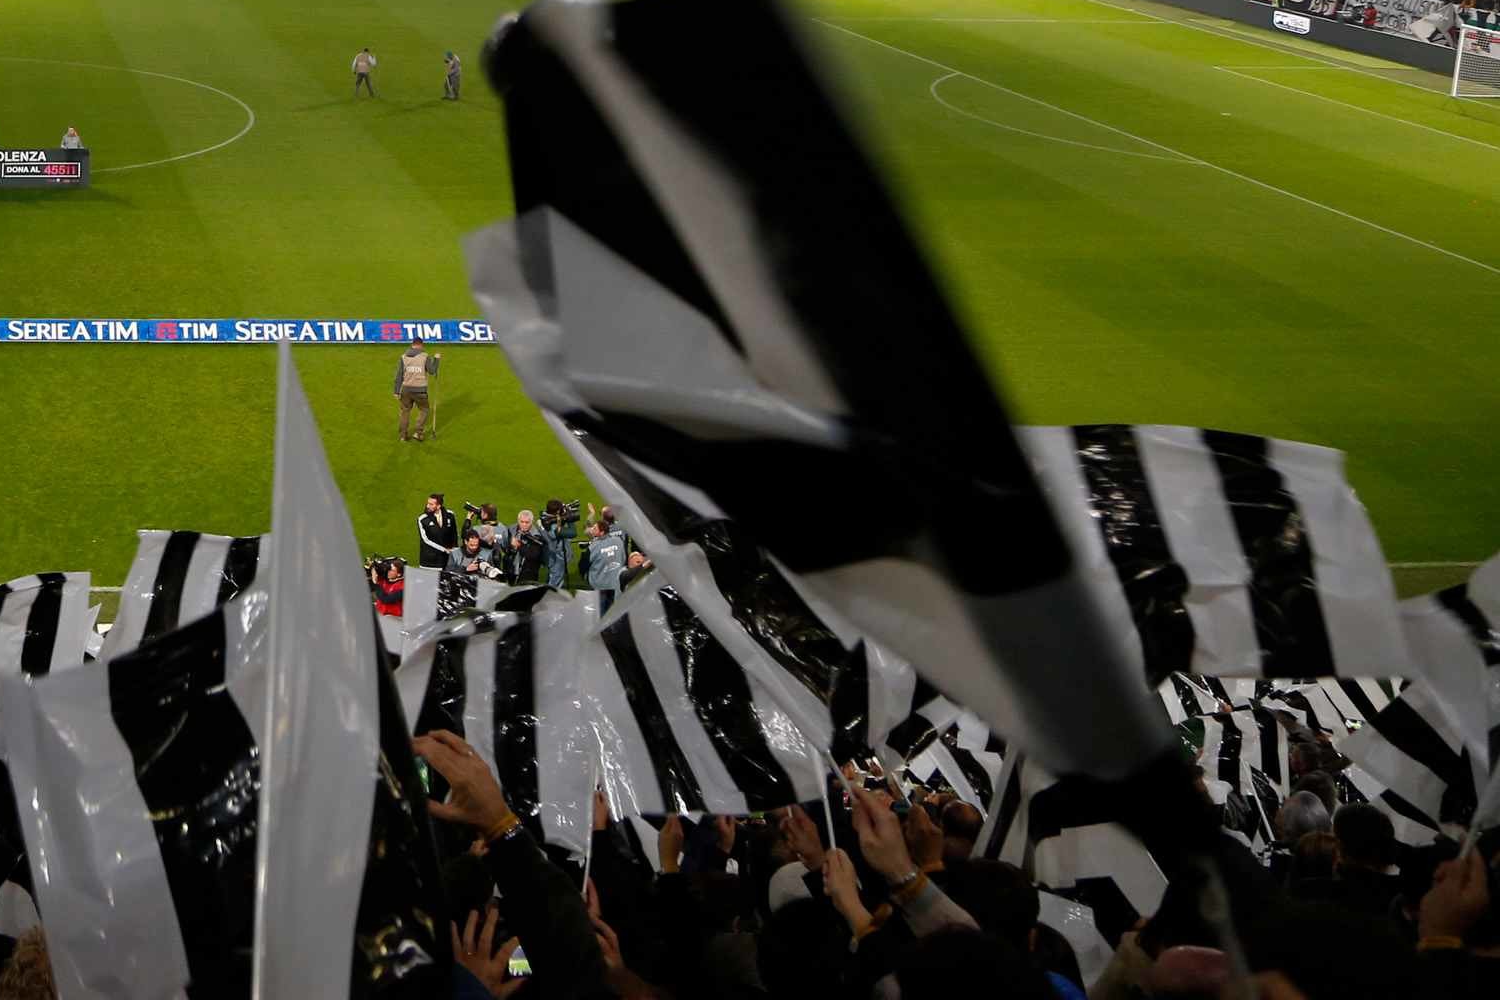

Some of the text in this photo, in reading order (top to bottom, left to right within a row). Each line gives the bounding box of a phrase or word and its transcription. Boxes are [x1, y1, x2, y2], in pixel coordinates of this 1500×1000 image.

[6, 165, 29, 173] DONA
[8, 320, 71, 340] SERIE
[91, 321, 138, 340] TIM
[178, 322, 218, 339] TIM
[235, 320, 298, 341] SERIE
[317, 321, 364, 341] TIM
[403, 323, 442, 340] TIM
